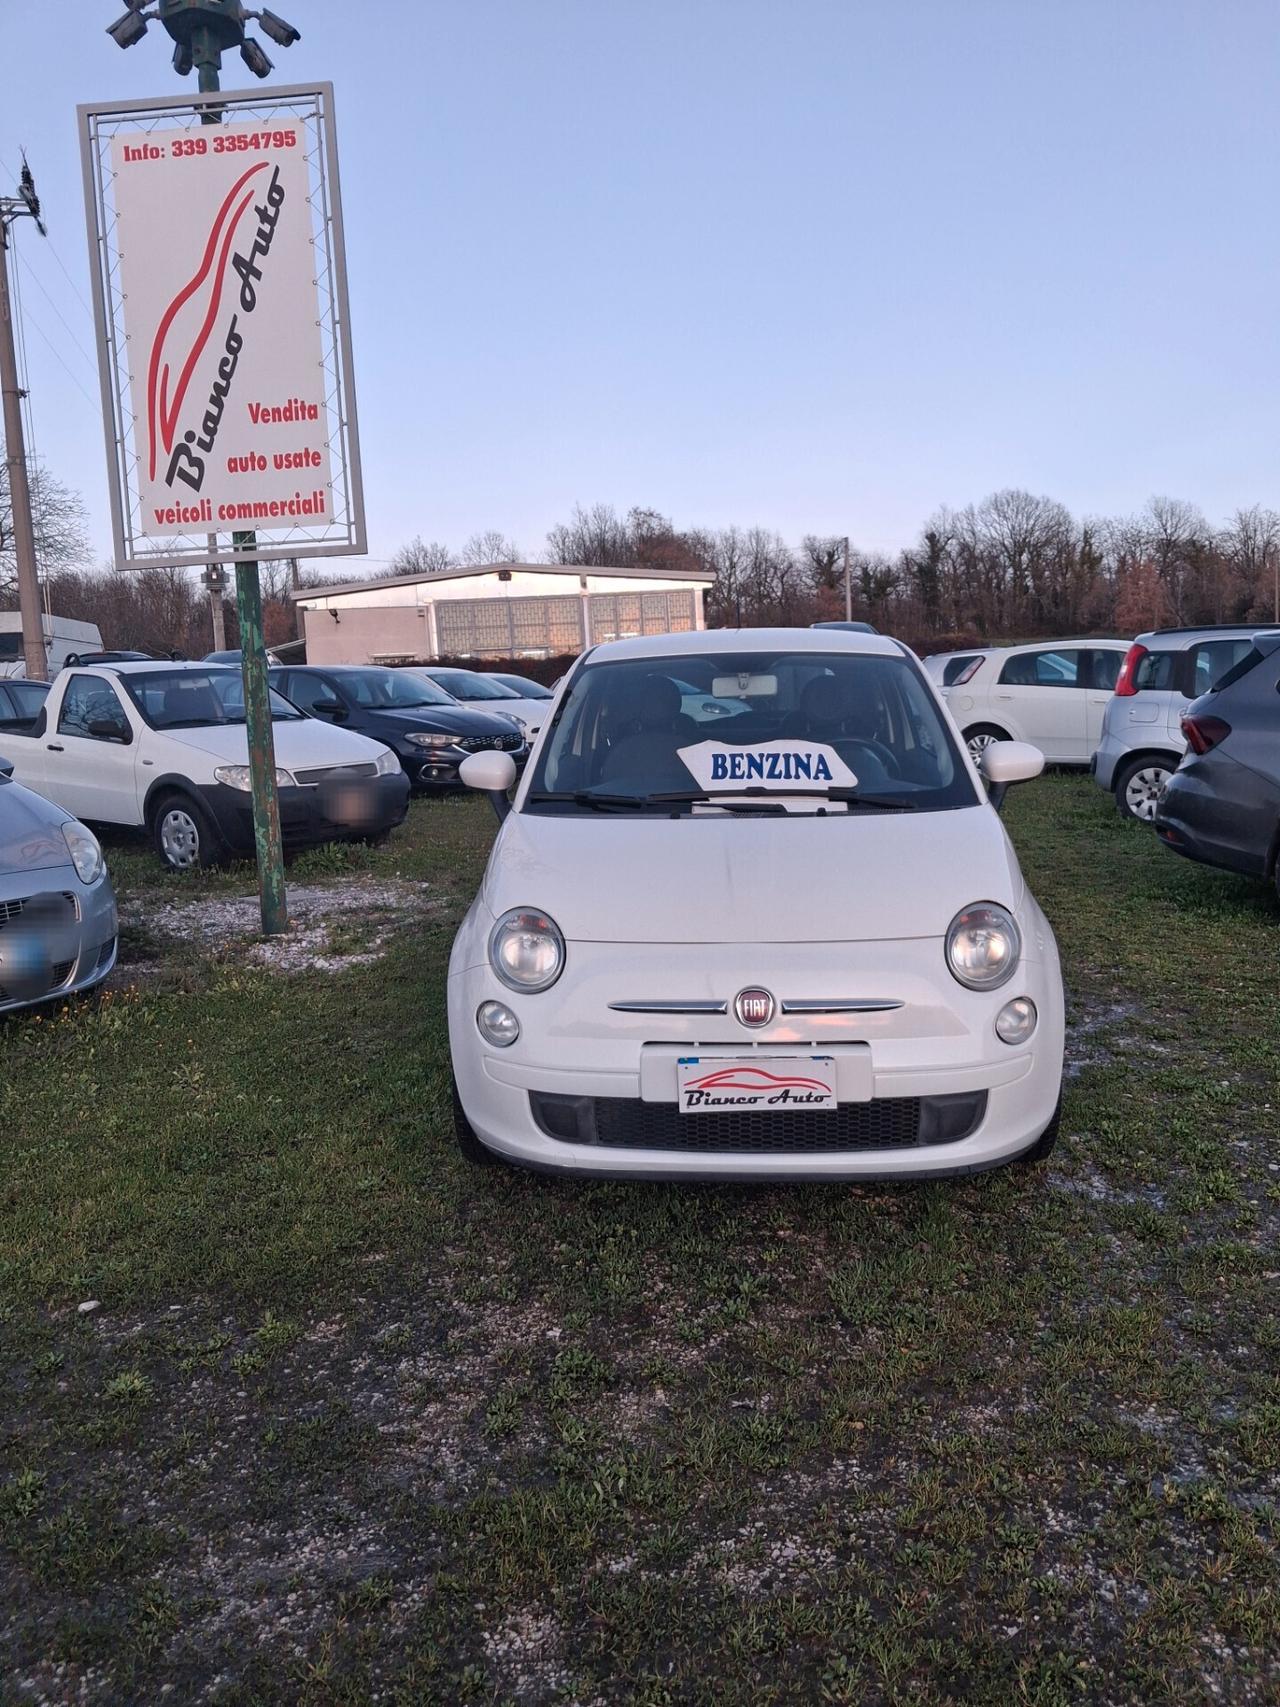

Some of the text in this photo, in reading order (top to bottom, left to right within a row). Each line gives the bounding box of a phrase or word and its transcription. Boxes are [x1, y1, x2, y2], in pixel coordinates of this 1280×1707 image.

[124, 129, 297, 162] Info: 339 3354795
[166, 165, 285, 492] Bianco Auto
[248, 399, 319, 425] Vendita
[227, 447, 321, 473] auto usate
[154, 491, 325, 525] veicoli commerciali
[711, 752, 833, 780] BENZINA
[743, 999, 767, 1017] FIAT
[684, 1088, 832, 1107] Bianco Auto
